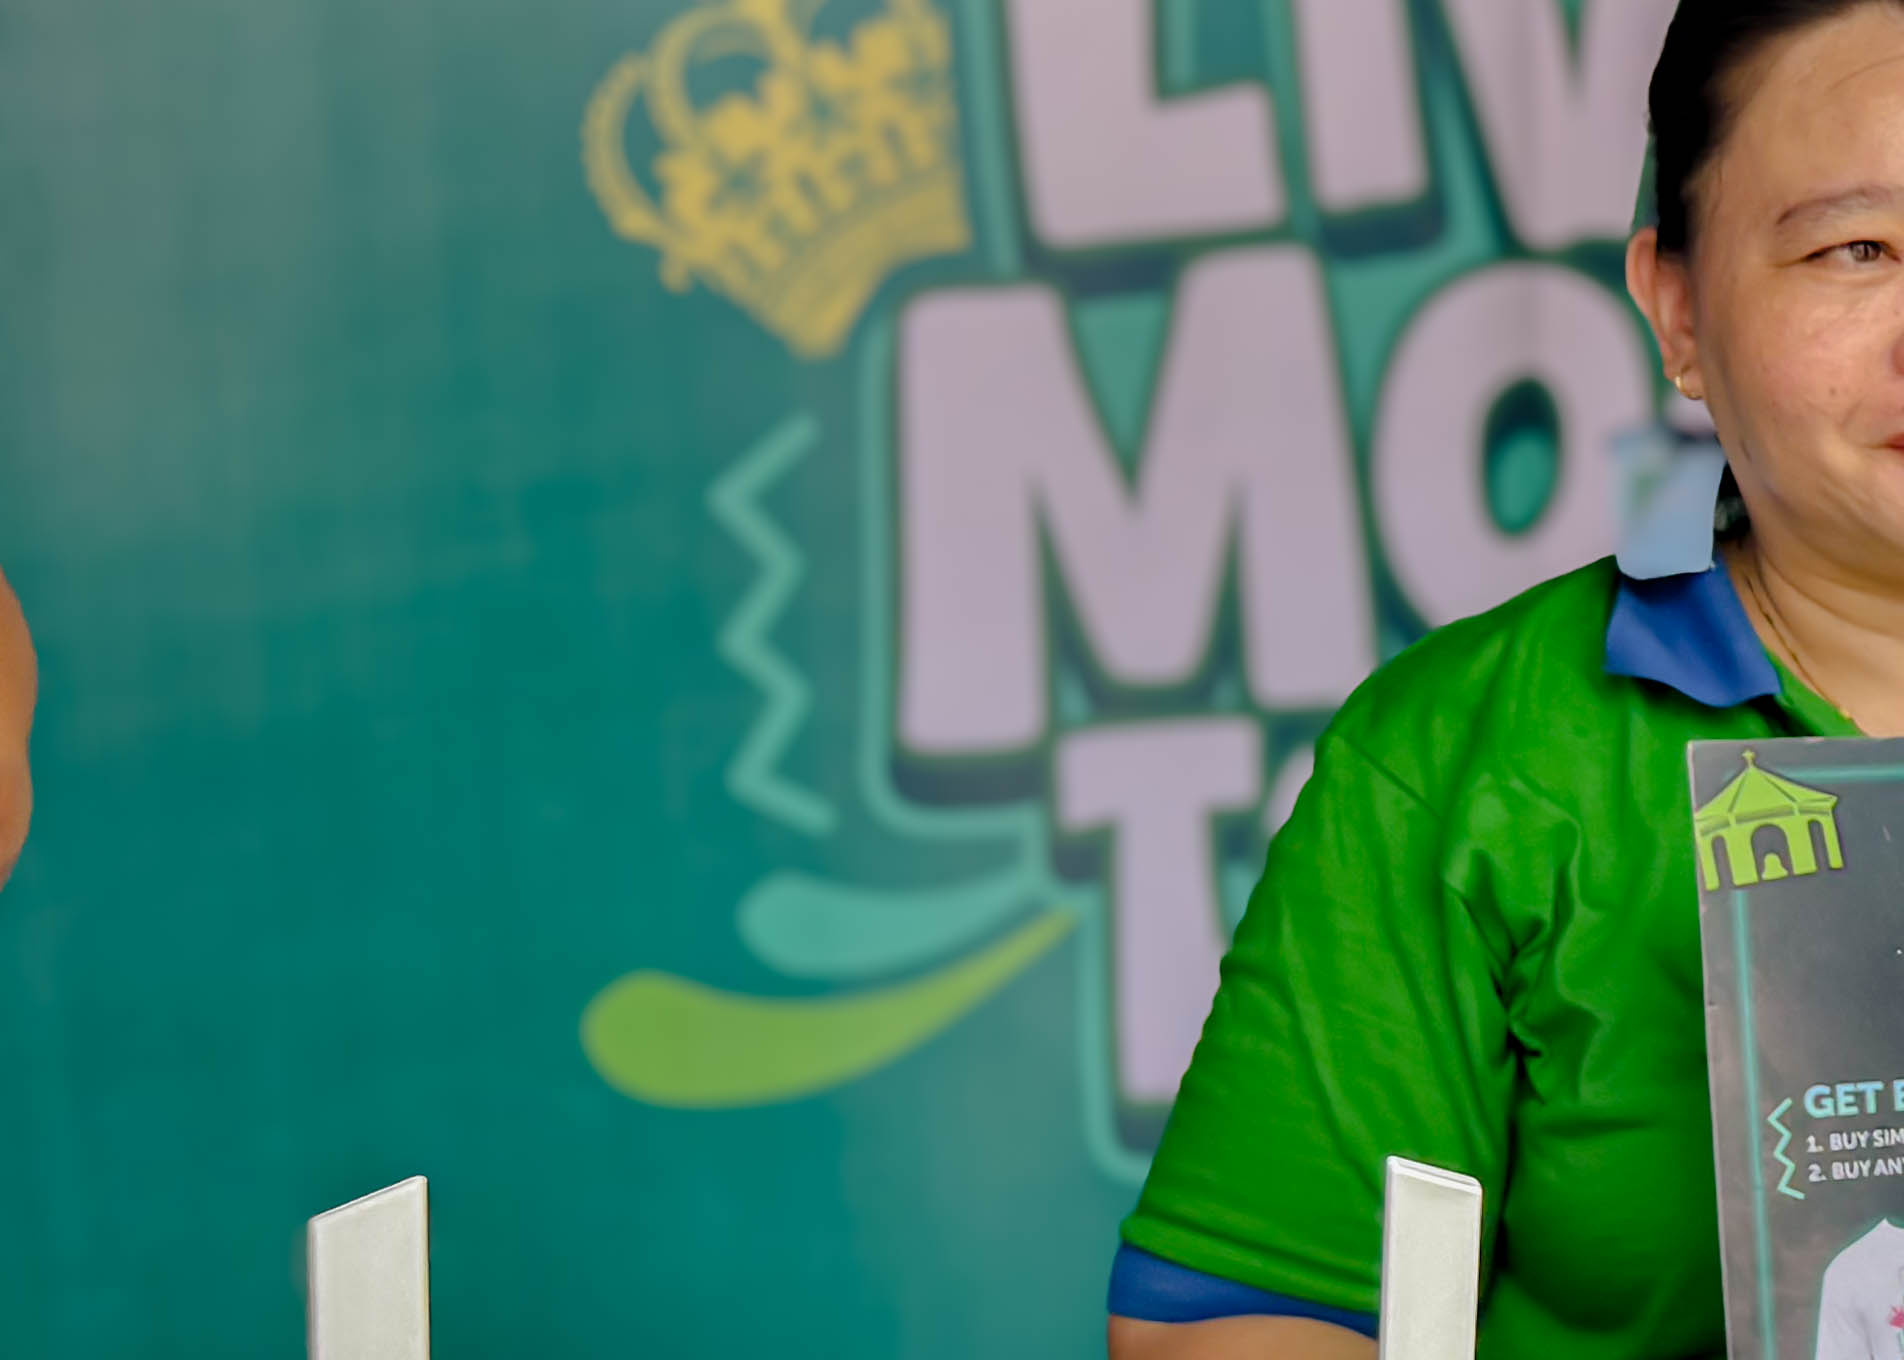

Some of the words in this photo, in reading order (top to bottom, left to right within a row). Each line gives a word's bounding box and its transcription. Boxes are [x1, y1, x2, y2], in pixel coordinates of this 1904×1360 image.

[1803, 1080, 1885, 1119] GET
[1806, 1134, 1825, 1154] 1.
[1829, 1129, 1869, 1152] BUY
[1808, 1163, 1827, 1183] 2.
[1831, 1158, 1871, 1181] BUY
